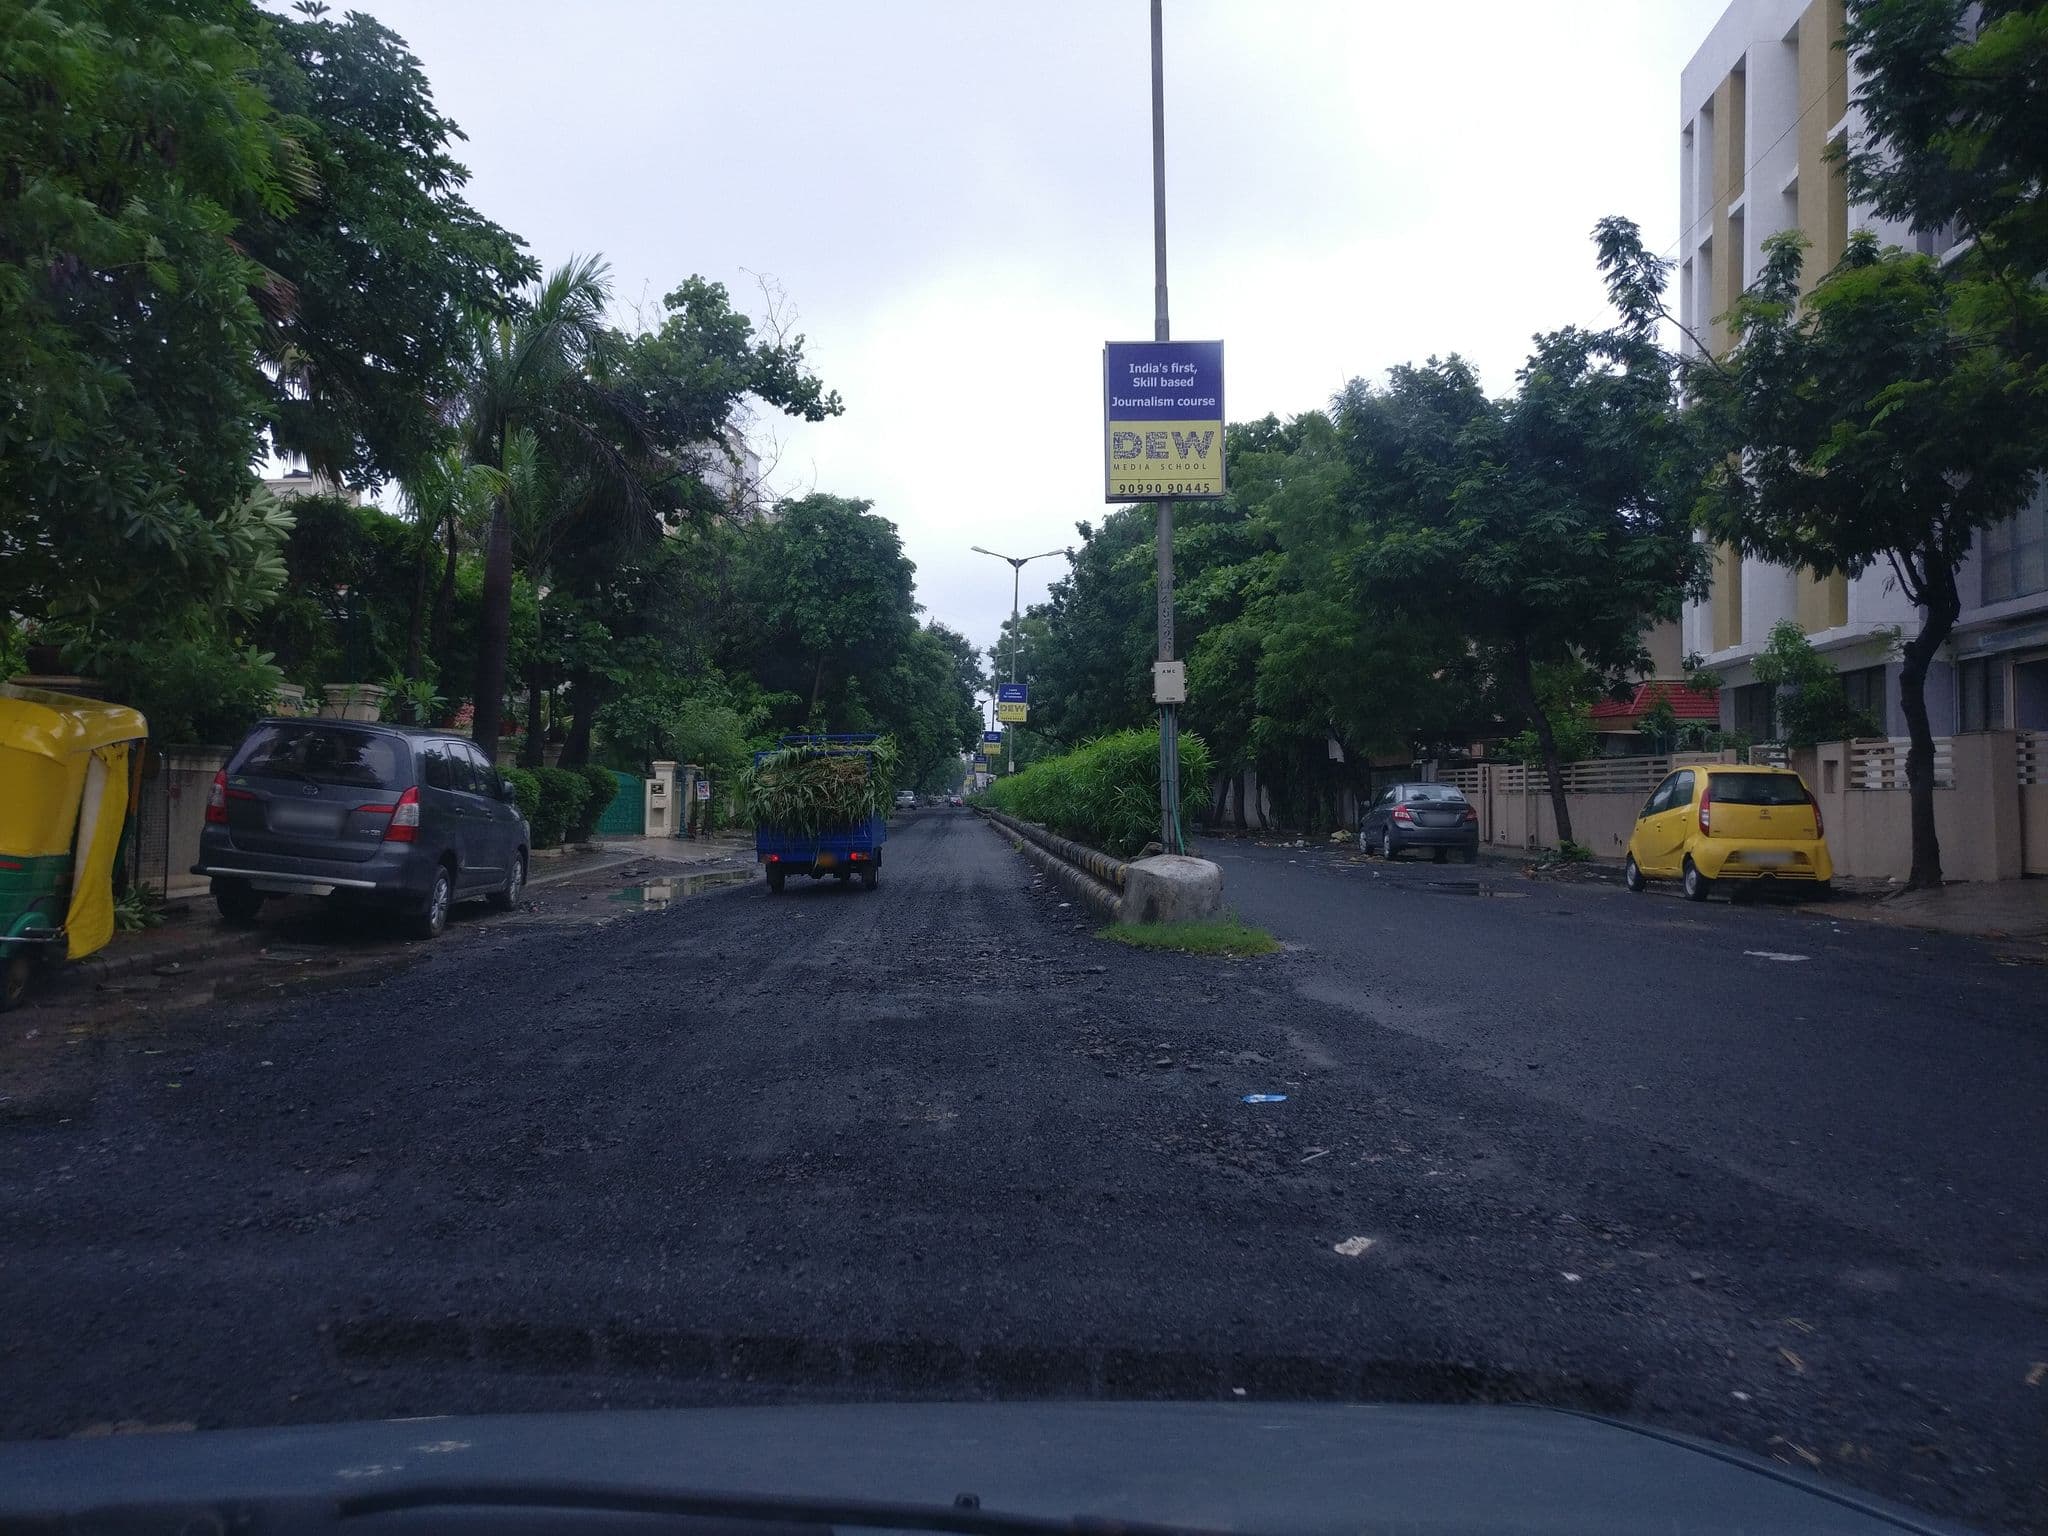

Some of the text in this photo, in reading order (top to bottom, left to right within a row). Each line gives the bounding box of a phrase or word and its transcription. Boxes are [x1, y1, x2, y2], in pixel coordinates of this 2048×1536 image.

[1129, 363, 1198, 375] India's first,
[1133, 377, 1194, 387] Skill based
[1112, 397, 1216, 407] Journalism course
[1113, 431, 1214, 459] DEW
[1113, 463, 1207, 471] MEDIA SCHOOL
[1119, 483, 1210, 493] 90990 90445
